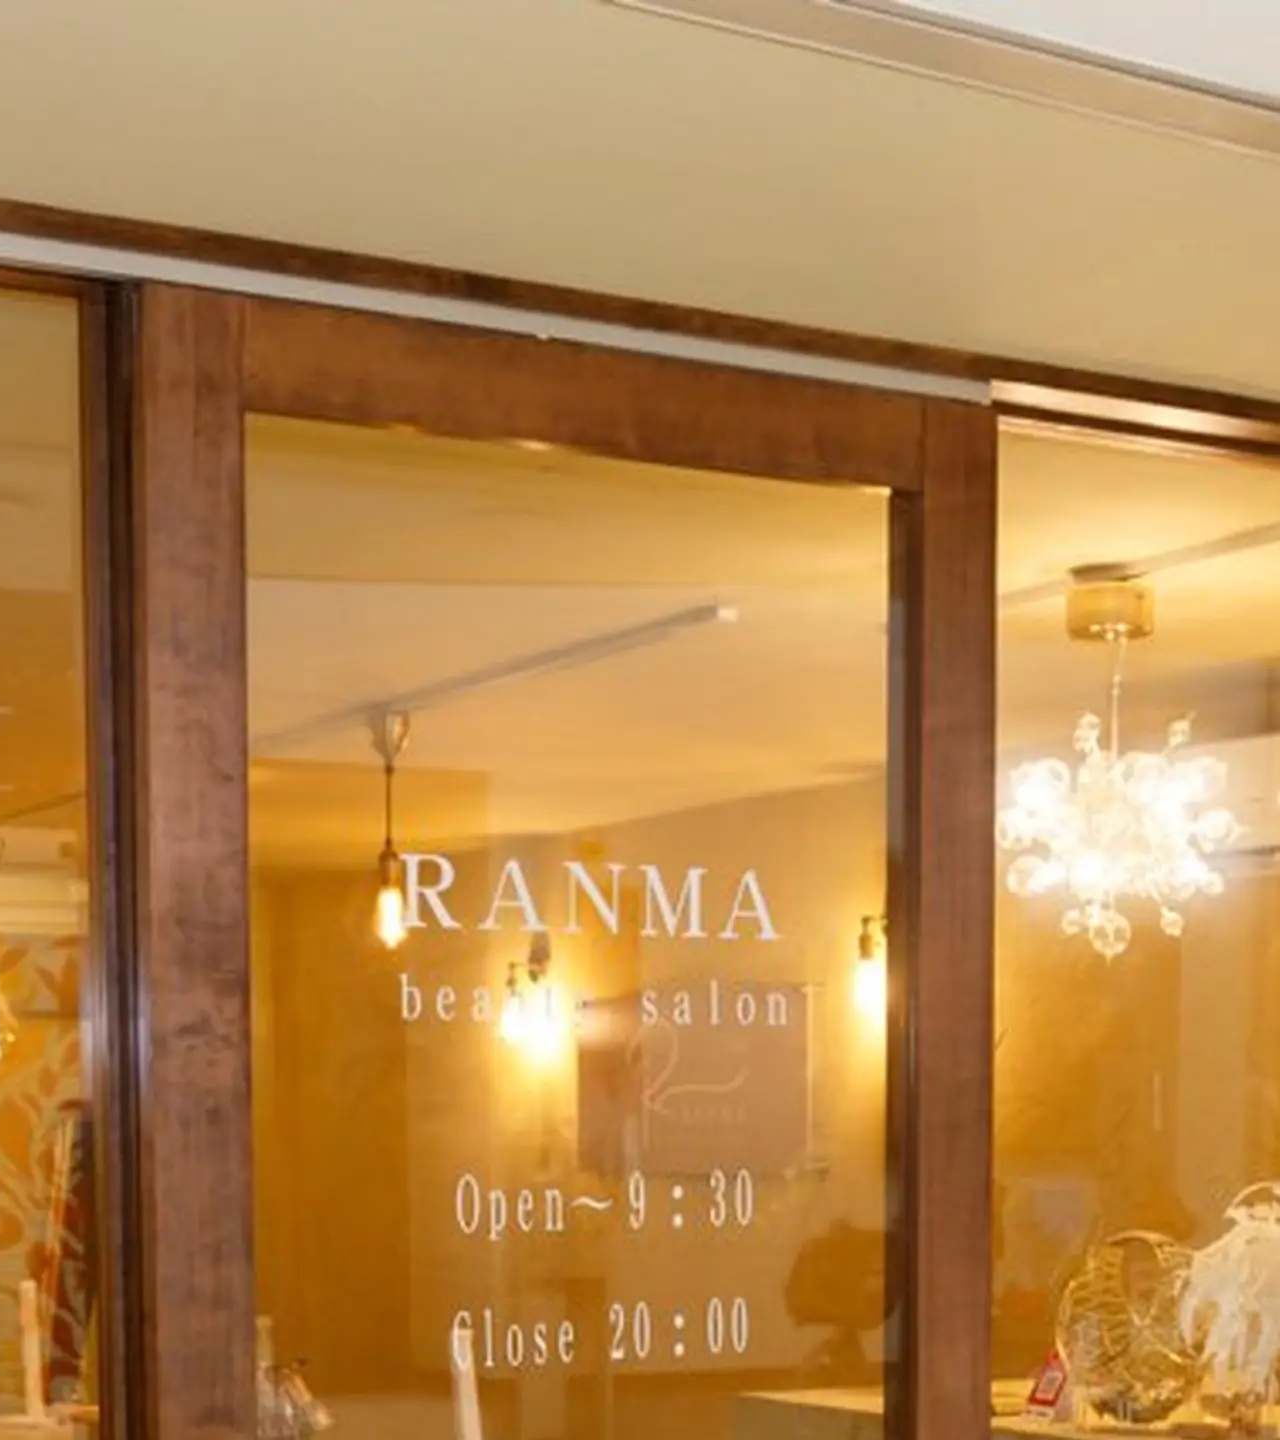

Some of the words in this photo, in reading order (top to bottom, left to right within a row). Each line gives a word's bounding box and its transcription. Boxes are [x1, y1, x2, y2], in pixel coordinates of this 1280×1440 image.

[399, 853, 782, 940] RANMA
[641, 979, 789, 1026] salon
[452, 1307, 575, 1371] Close
